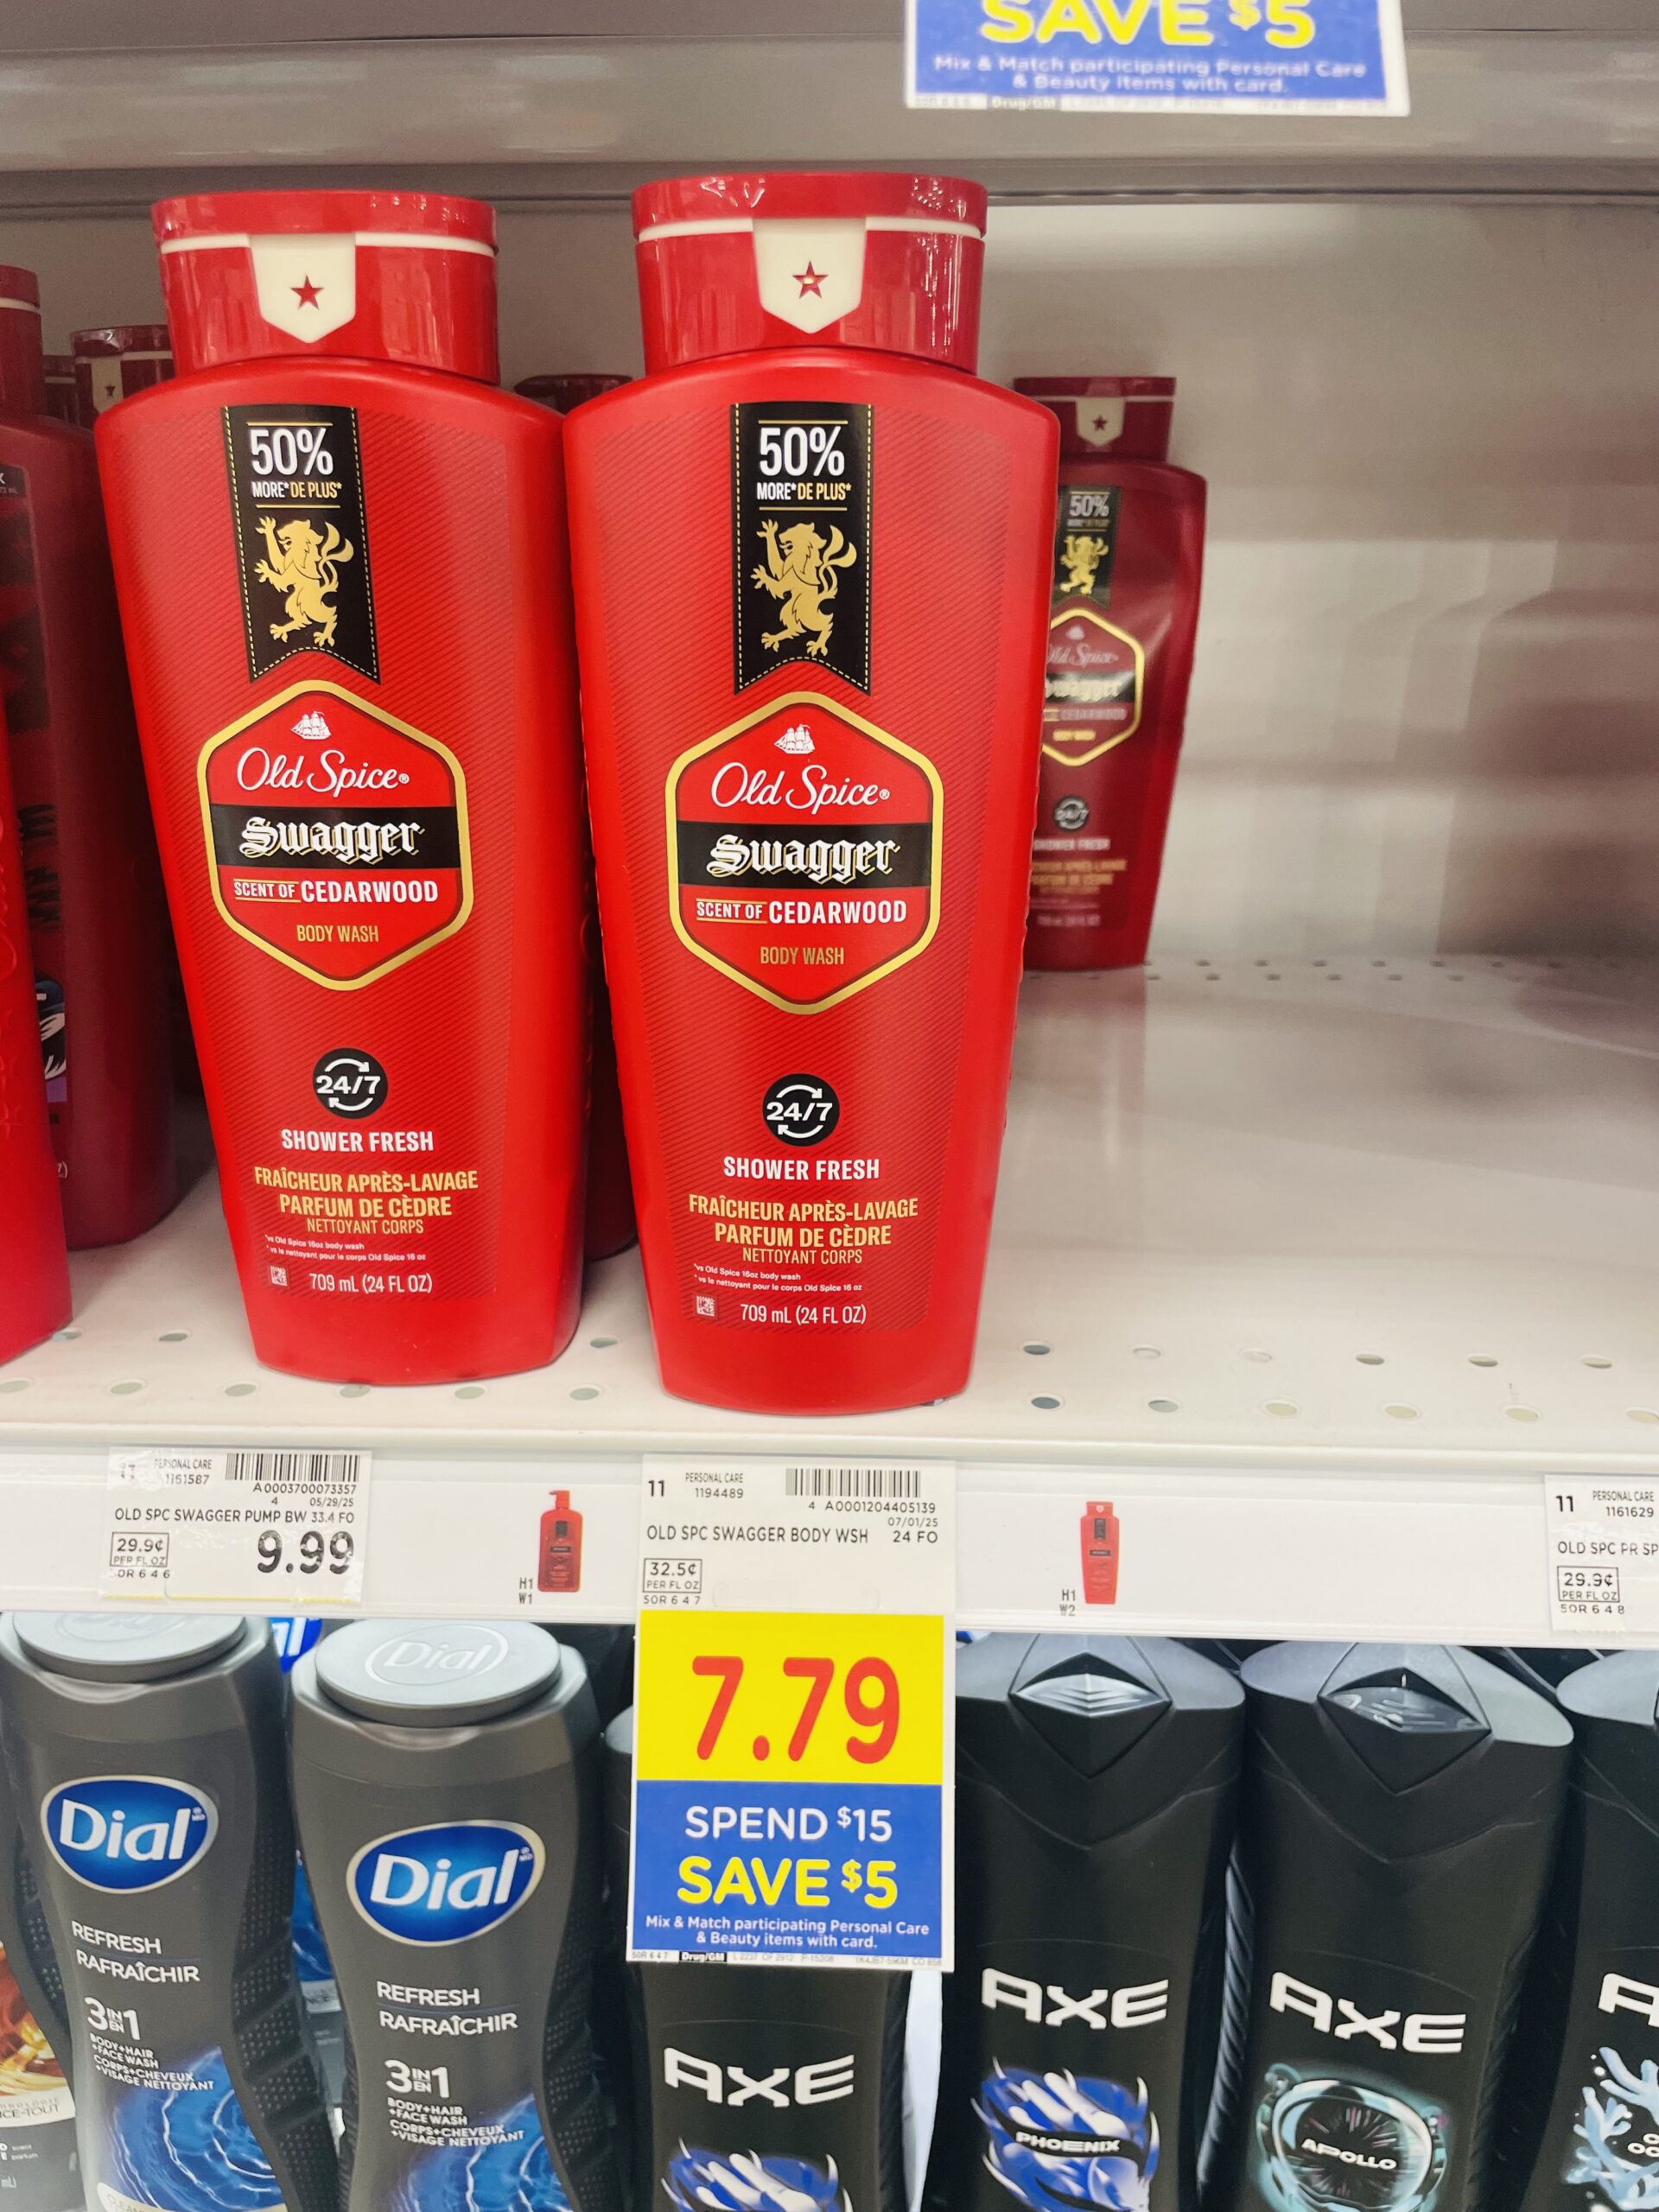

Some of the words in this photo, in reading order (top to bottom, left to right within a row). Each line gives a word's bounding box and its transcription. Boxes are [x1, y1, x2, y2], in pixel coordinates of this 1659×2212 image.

[981, 0, 1213, 45] SAVE
[1229, 0, 1316, 48] $5
[934, 55, 971, 72] Mix
[977, 55, 992, 72] &
[999, 55, 1063, 72] Match
[1070, 57, 1209, 77] participating
[1216, 60, 1309, 76] Personal
[1315, 61, 1366, 77] Care
[1013, 73, 1027, 89] &
[1034, 73, 1109, 92] Beauty
[1117, 75, 1175, 91] items
[1183, 76, 1228, 92] with
[250, 427, 334, 475] 50%
[759, 426, 845, 476] 50%
[289, 481, 306, 499] DE
[798, 482, 813, 500] DE
[237, 747, 304, 791] Old
[711, 762, 785, 807] Old
[238, 816, 425, 865] Swagger
[706, 834, 901, 885] Swagger
[234, 881, 275, 898] SCENT
[278, 883, 296, 899] OF
[302, 880, 438, 903] CEDARWOOD
[696, 901, 741, 918] SCENT
[745, 904, 762, 919] OF
[768, 900, 906, 925] CEDARWOOD
[296, 925, 333, 943] BODY
[338, 925, 379, 943] WASH
[760, 946, 798, 965] BODY
[803, 947, 844, 965] WASH
[315, 1075, 381, 1095] 24/7
[766, 1102, 833, 1122] 24/7
[281, 1128, 364, 1153] SHOWER
[369, 1130, 434, 1153] FRESH
[254, 1166, 343, 1192] FRAÎCHEUR
[347, 1170, 478, 1192] APRÈS-LAVAGE
[723, 1156, 809, 1180] SHOWER
[816, 1159, 880, 1180] FRESH
[279, 1193, 353, 1217] PARFUM
[359, 1198, 385, 1217] DE
[388, 1194, 452, 1217] CÈDRE
[689, 1194, 785, 1221] FRAÎCHEUR
[788, 1198, 918, 1222] APRÈS-LAVAGE
[307, 1218, 378, 1235] NETTOYANT
[382, 1218, 423, 1235] CORPS
[715, 1223, 793, 1247] PARFUM
[799, 1227, 824, 1247] DE
[829, 1224, 891, 1247] CÈDRE
[742, 1248, 817, 1264] NETTOYANT
[821, 1249, 863, 1264] CORPS
[705, 1265, 718, 1274] Old
[720, 1268, 740, 1278] Spice
[742, 1270, 759, 1279] 16oz
[760, 1272, 779, 1281] body
[741, 1303, 767, 1323] 709
[772, 1306, 791, 1324] mL
[796, 1304, 818, 1325] (24
[823, 1306, 838, 1325] FL
[842, 1303, 867, 1325] OZ)
[648, 1479, 664, 1497] 11
[685, 1471, 722, 1483] PERSONAL
[725, 1472, 744, 1484] CARE
[309, 1497, 353, 1507] 05/29/25
[695, 1487, 744, 1498] 1194489
[1592, 1491, 1631, 1501] PERSONAL
[1635, 1491, 1655, 1502] CARE
[809, 1501, 815, 1510] 4
[825, 1501, 936, 1513] A0001204405139
[1555, 1496, 1574, 1512] 11
[1605, 1506, 1654, 1517] 1161629
[115, 1508, 141, 1521] OLD
[145, 1508, 170, 1521] SPC
[174, 1509, 240, 1522] SWAGGER
[245, 1510, 281, 1522] PUMP
[285, 1510, 307, 1522] BW
[339, 1512, 354, 1523] FO
[887, 1516, 938, 1528] 07/01/25
[117, 1538, 163, 1552] 29.9¢
[647, 1525, 677, 1540] OLD
[682, 1525, 708, 1541] SPC
[713, 1526, 785, 1541] SWAGGER
[791, 1527, 830, 1543] BODY
[836, 1528, 868, 1543] WSH
[893, 1530, 911, 1543] 24
[917, 1531, 938, 1543] FO
[257, 1529, 354, 1574] 9.99
[1558, 1541, 1586, 1554] OLD
[1591, 1541, 1616, 1554] SPC
[1621, 1543, 1638, 1555] PR
[651, 1562, 696, 1576] 32.5¢
[519, 1577, 533, 1589] H1
[646, 1580, 666, 1589] PER
[670, 1580, 681, 1589] FL
[684, 1580, 699, 1590] OZ
[518, 1592, 532, 1605] W1
[1062, 1589, 1076, 1601] H1
[385, 1640, 493, 1670] Dial
[692, 1656, 900, 1764] 7.79
[60, 1798, 191, 1861] Dial
[685, 1805, 828, 1840] SPEND
[837, 1806, 892, 1842] $15
[371, 1848, 519, 1910] Dial
[677, 1855, 830, 1906] SAVE
[842, 1859, 898, 1908] $5
[645, 1915, 671, 1928] Mix
[674, 1915, 683, 1928] &
[688, 1916, 730, 1929] Match
[734, 1916, 826, 1934] participating
[830, 1919, 892, 1934] Personal
[896, 1922, 930, 1935] Care
[72, 1920, 162, 1955] REFRESH
[696, 1930, 706, 1943] &
[710, 1931, 760, 1947] Beauty
[764, 1932, 803, 1946] items
[807, 1934, 837, 1947] with
[841, 1935, 878, 1948] card.
[77, 1949, 200, 1983] RAFRAÎCHIR
[376, 1980, 480, 2006] REFRESH
[982, 1967, 1168, 2030] AXE
[379, 2010, 518, 2037] RAFRAÎCHIR
[1269, 1972, 1466, 2054] AXE
[664, 2047, 855, 2107] AXE
[429, 2114, 467, 2126] WASH
[449, 2130, 524, 2146] NETTOYANT
[1015, 2131, 1121, 2153] PHOENIX
[1300, 2138, 1397, 2171] APOLLO
